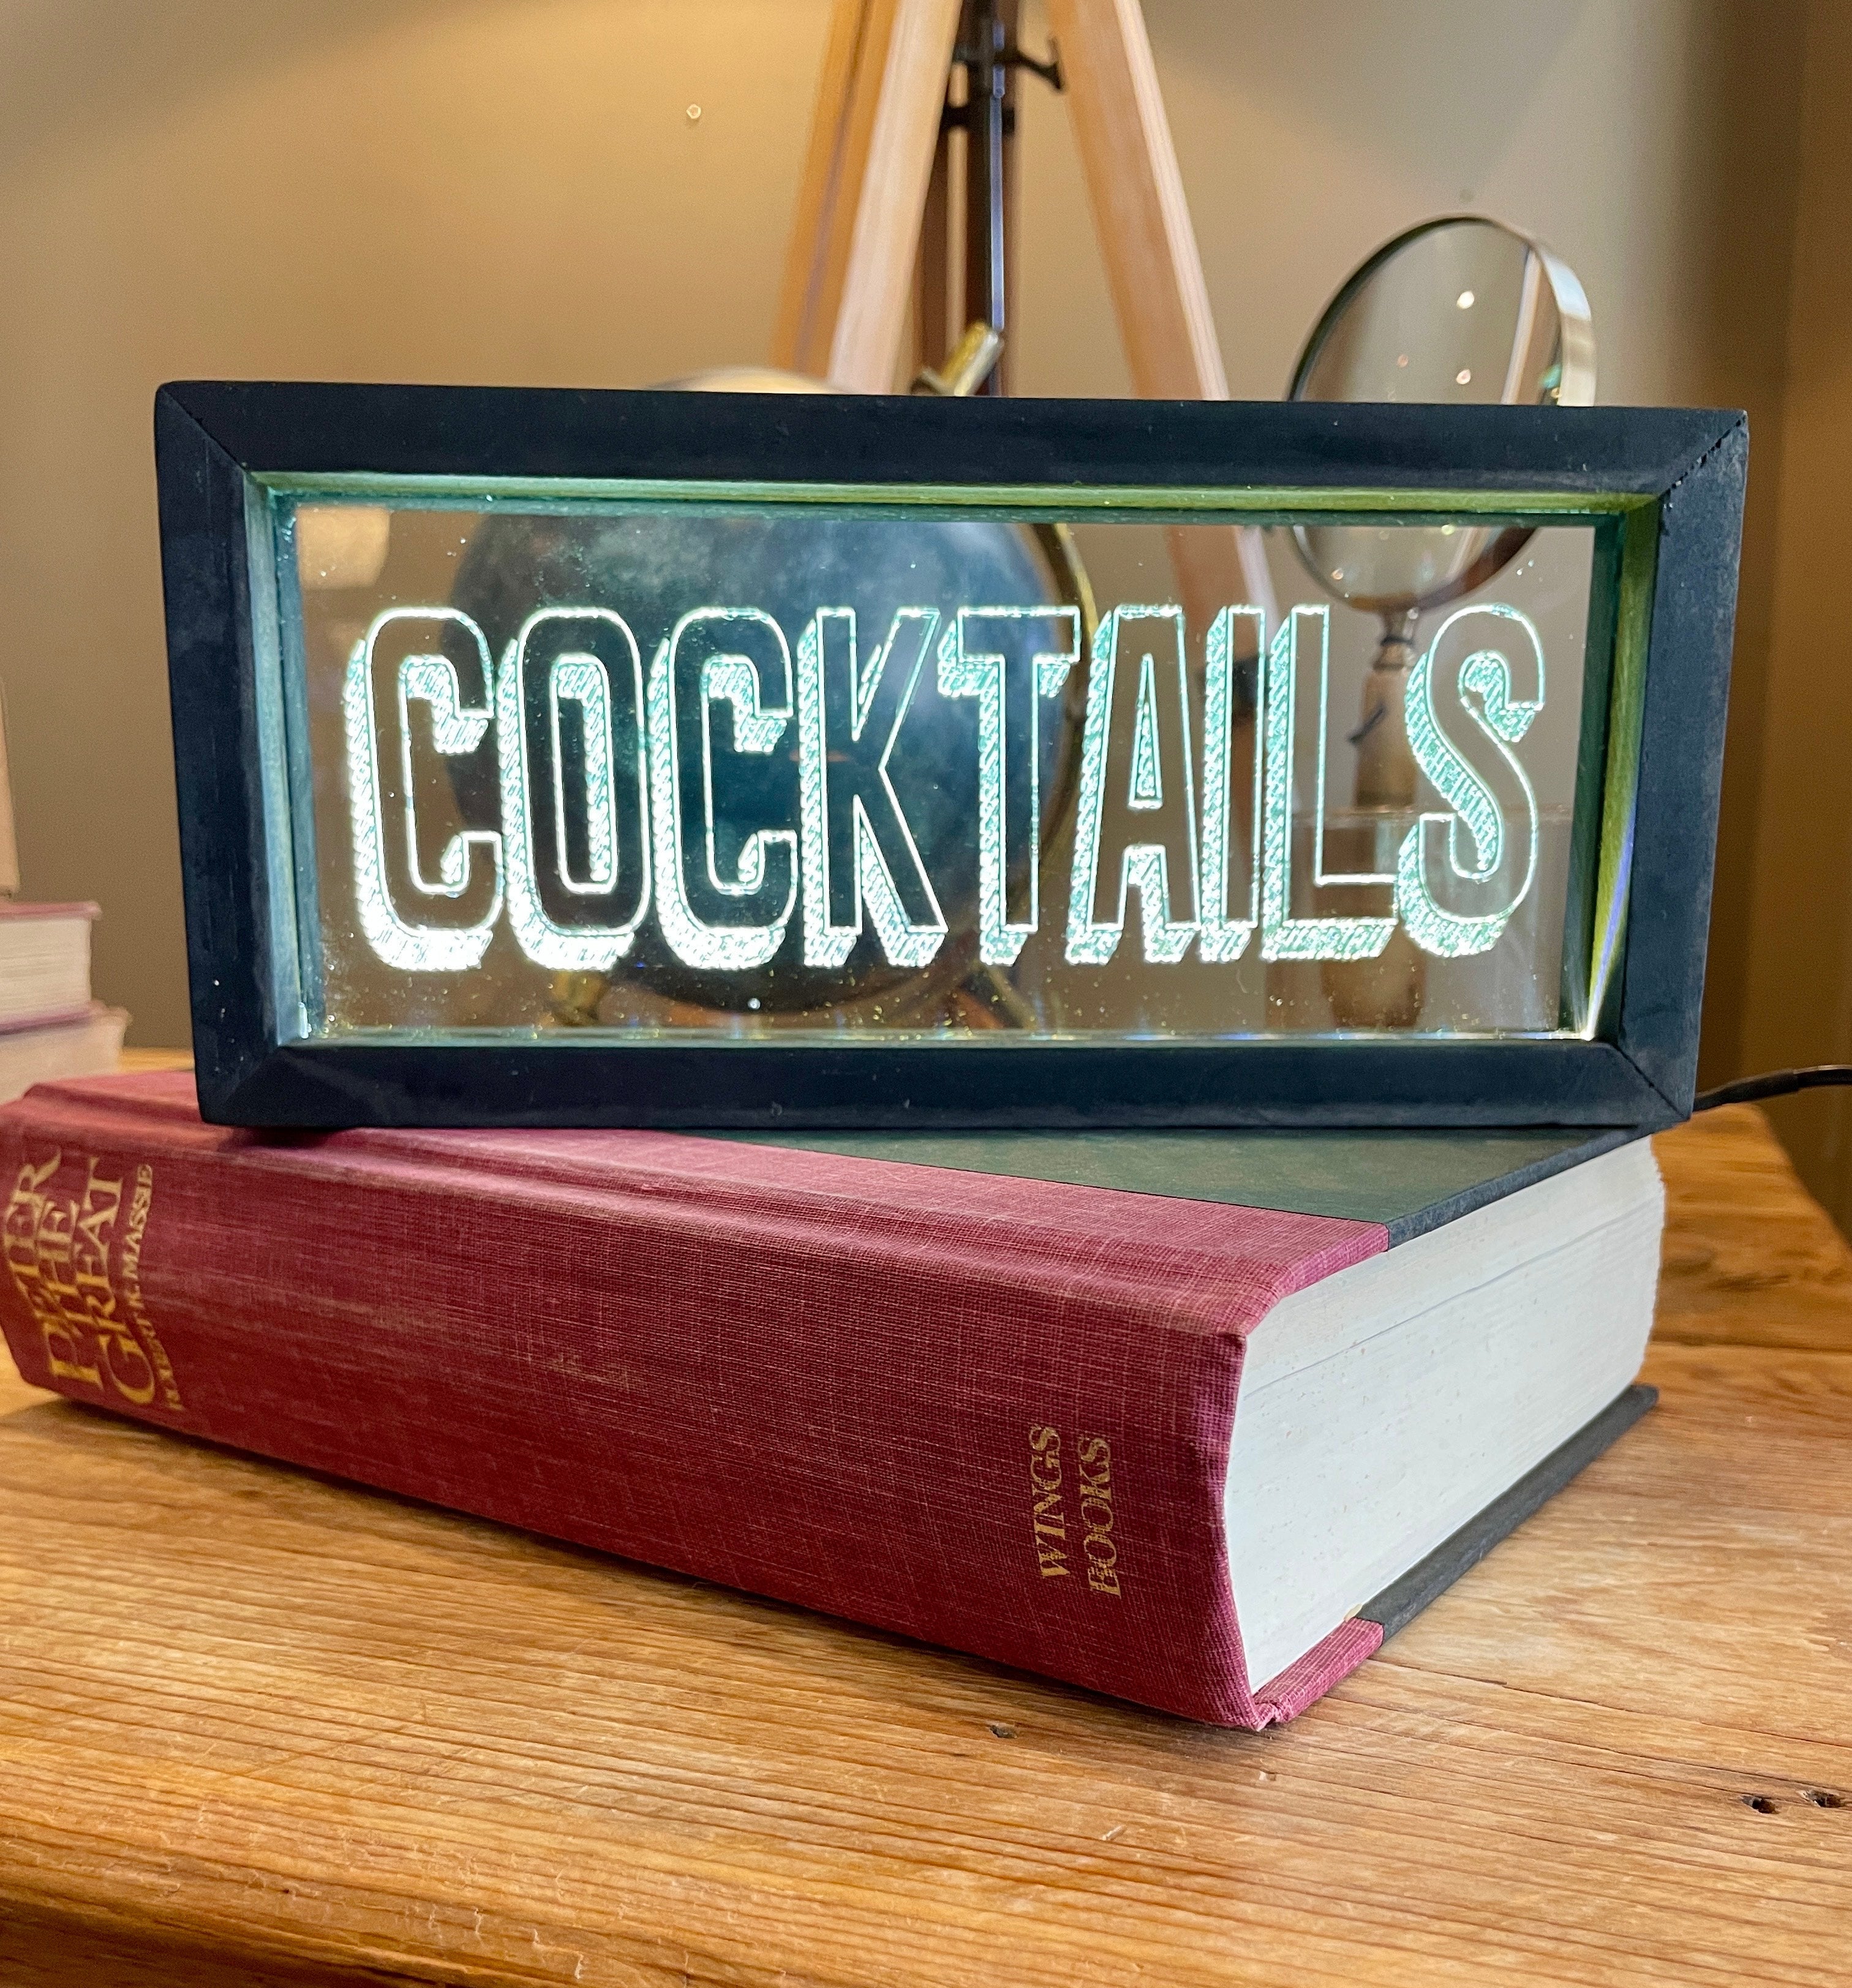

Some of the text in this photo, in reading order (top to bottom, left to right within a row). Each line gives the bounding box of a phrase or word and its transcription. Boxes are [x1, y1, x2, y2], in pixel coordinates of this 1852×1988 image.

[343, 606, 1547, 973] COCKTAILS
[75, 1157, 154, 1404] GREAT
[1029, 1423, 1070, 1577] WINGS
[1077, 1436, 1121, 1599] BOOKS
